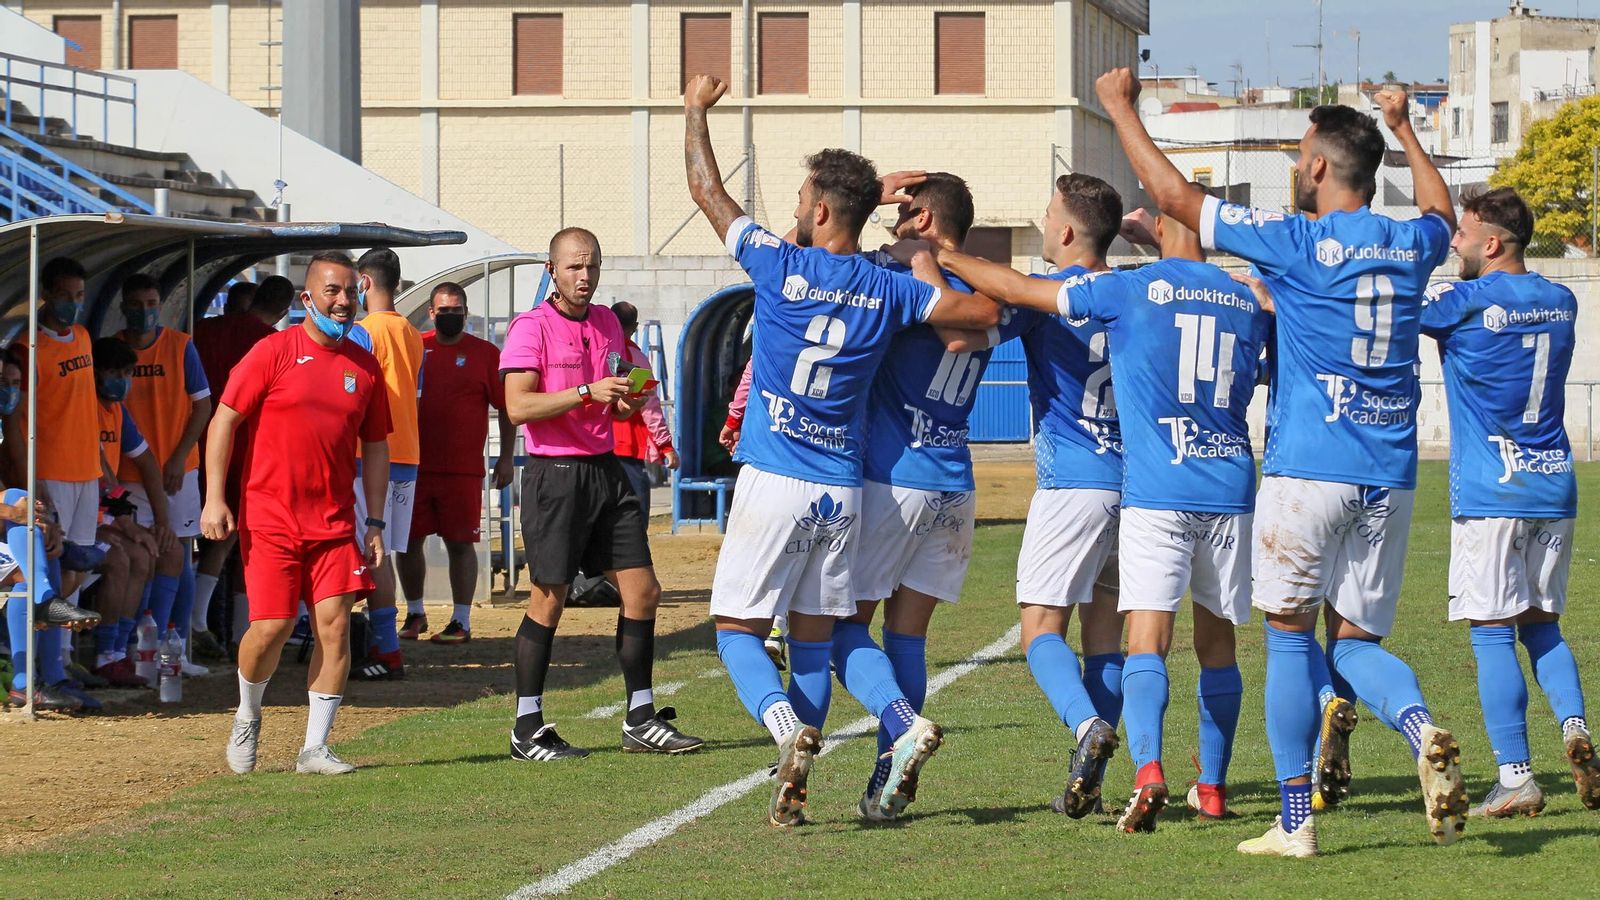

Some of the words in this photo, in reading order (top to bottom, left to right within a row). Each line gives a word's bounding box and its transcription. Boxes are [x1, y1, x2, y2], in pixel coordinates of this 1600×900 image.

[1344, 243, 1420, 262] duokitchen
[1175, 286, 1254, 313] duokitchen
[1351, 273, 1395, 367] 9
[790, 314, 846, 399] 2
[1174, 313, 1236, 408] 14
[1521, 333, 1550, 423] 7
[1361, 391, 1410, 411] Soccer
